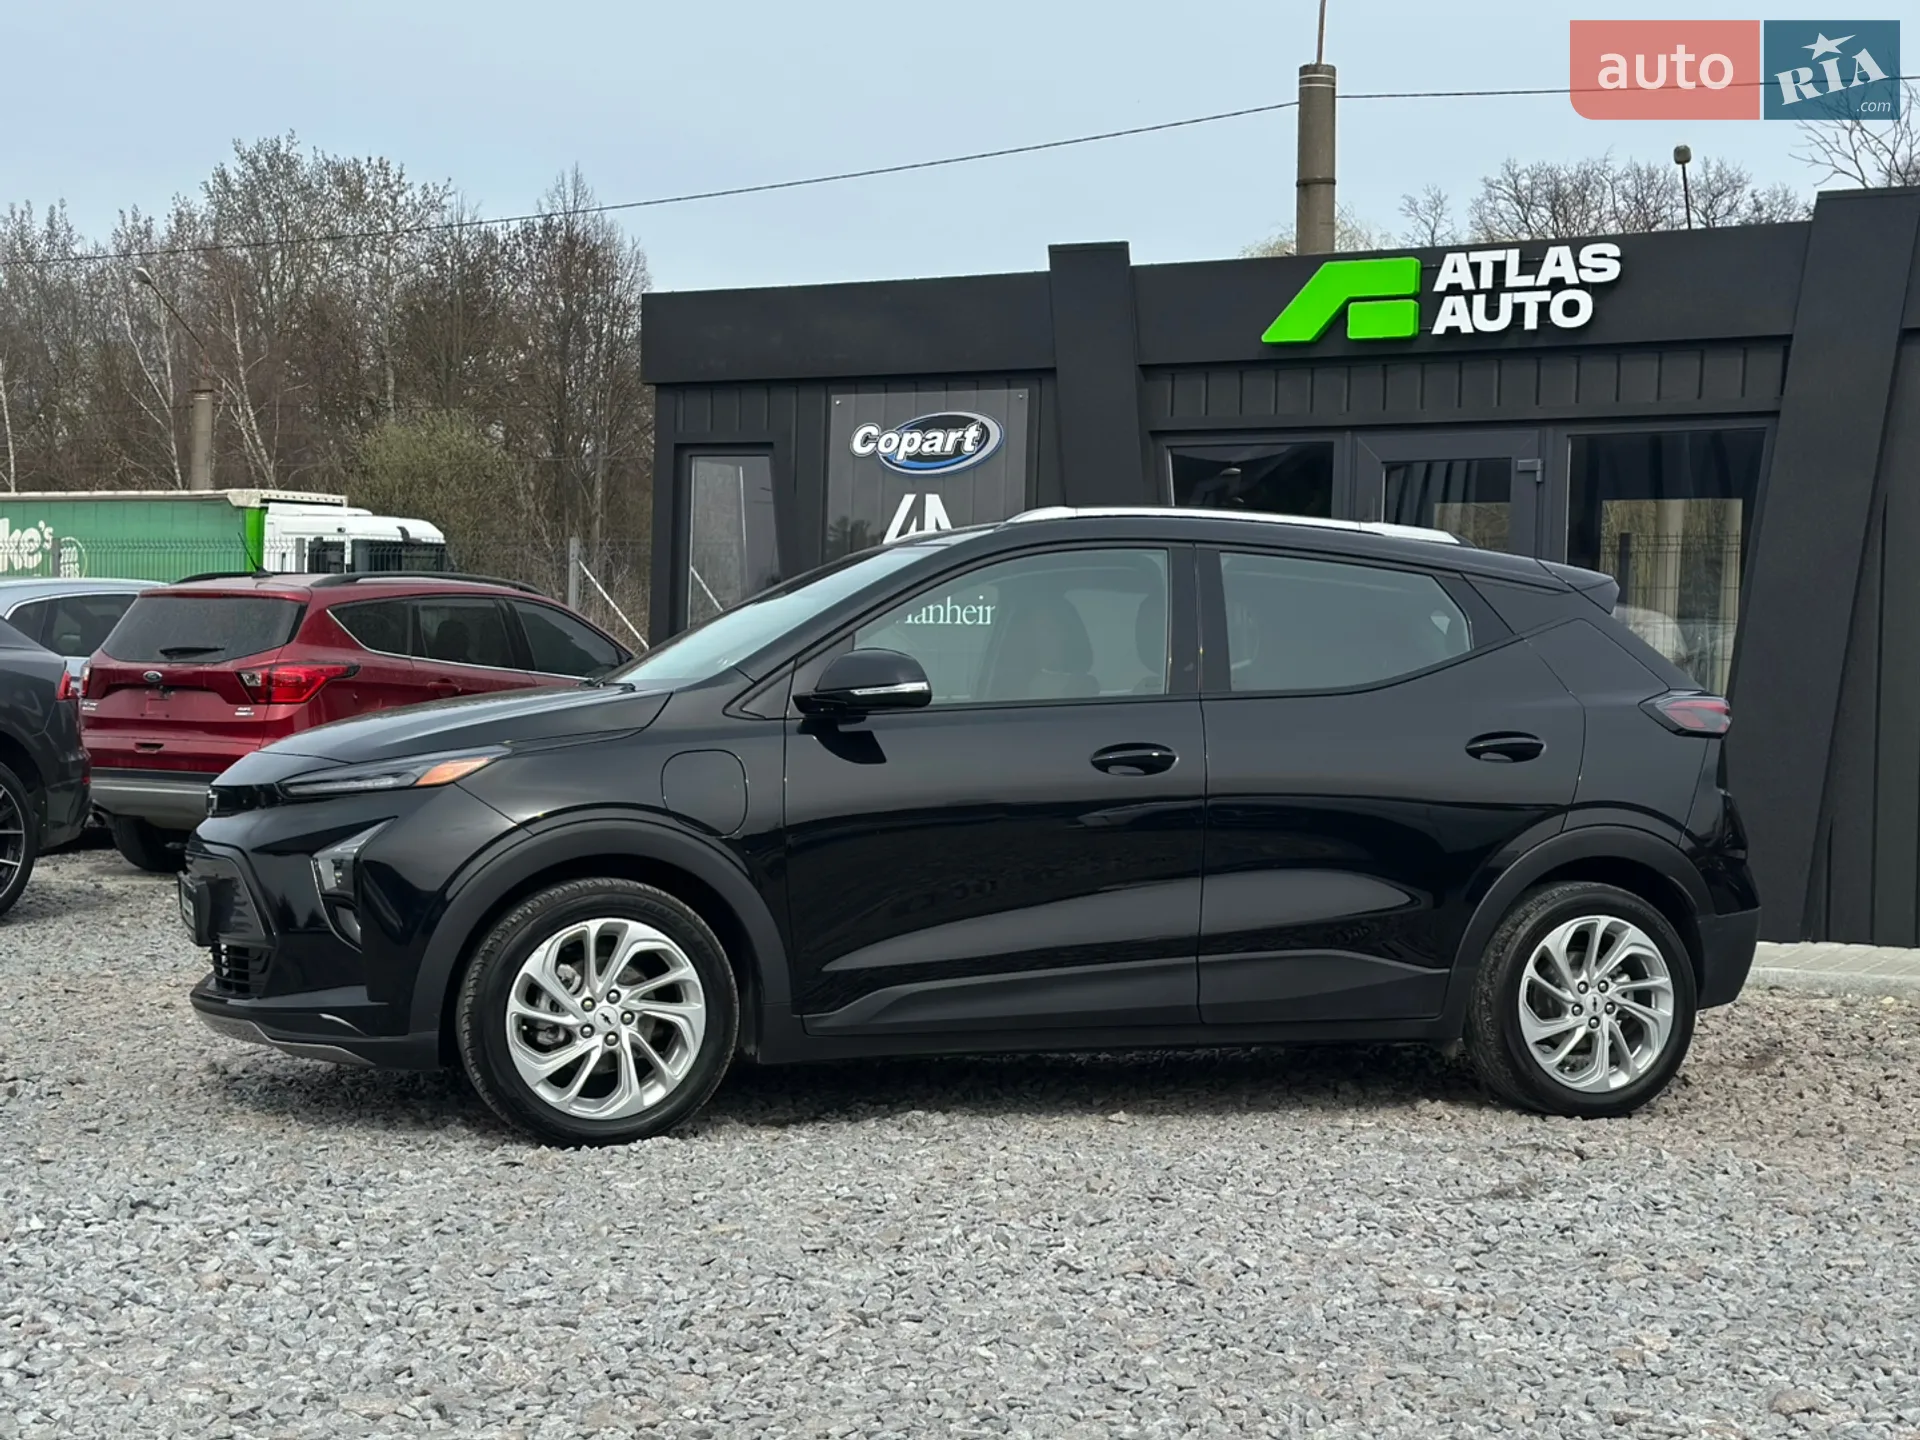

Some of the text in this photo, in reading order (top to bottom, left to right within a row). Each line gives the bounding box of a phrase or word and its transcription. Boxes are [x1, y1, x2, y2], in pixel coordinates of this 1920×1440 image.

[1433, 243, 1621, 292] ATLAS
[1431, 289, 1593, 335] AUTO
[852, 421, 982, 462] Copart
